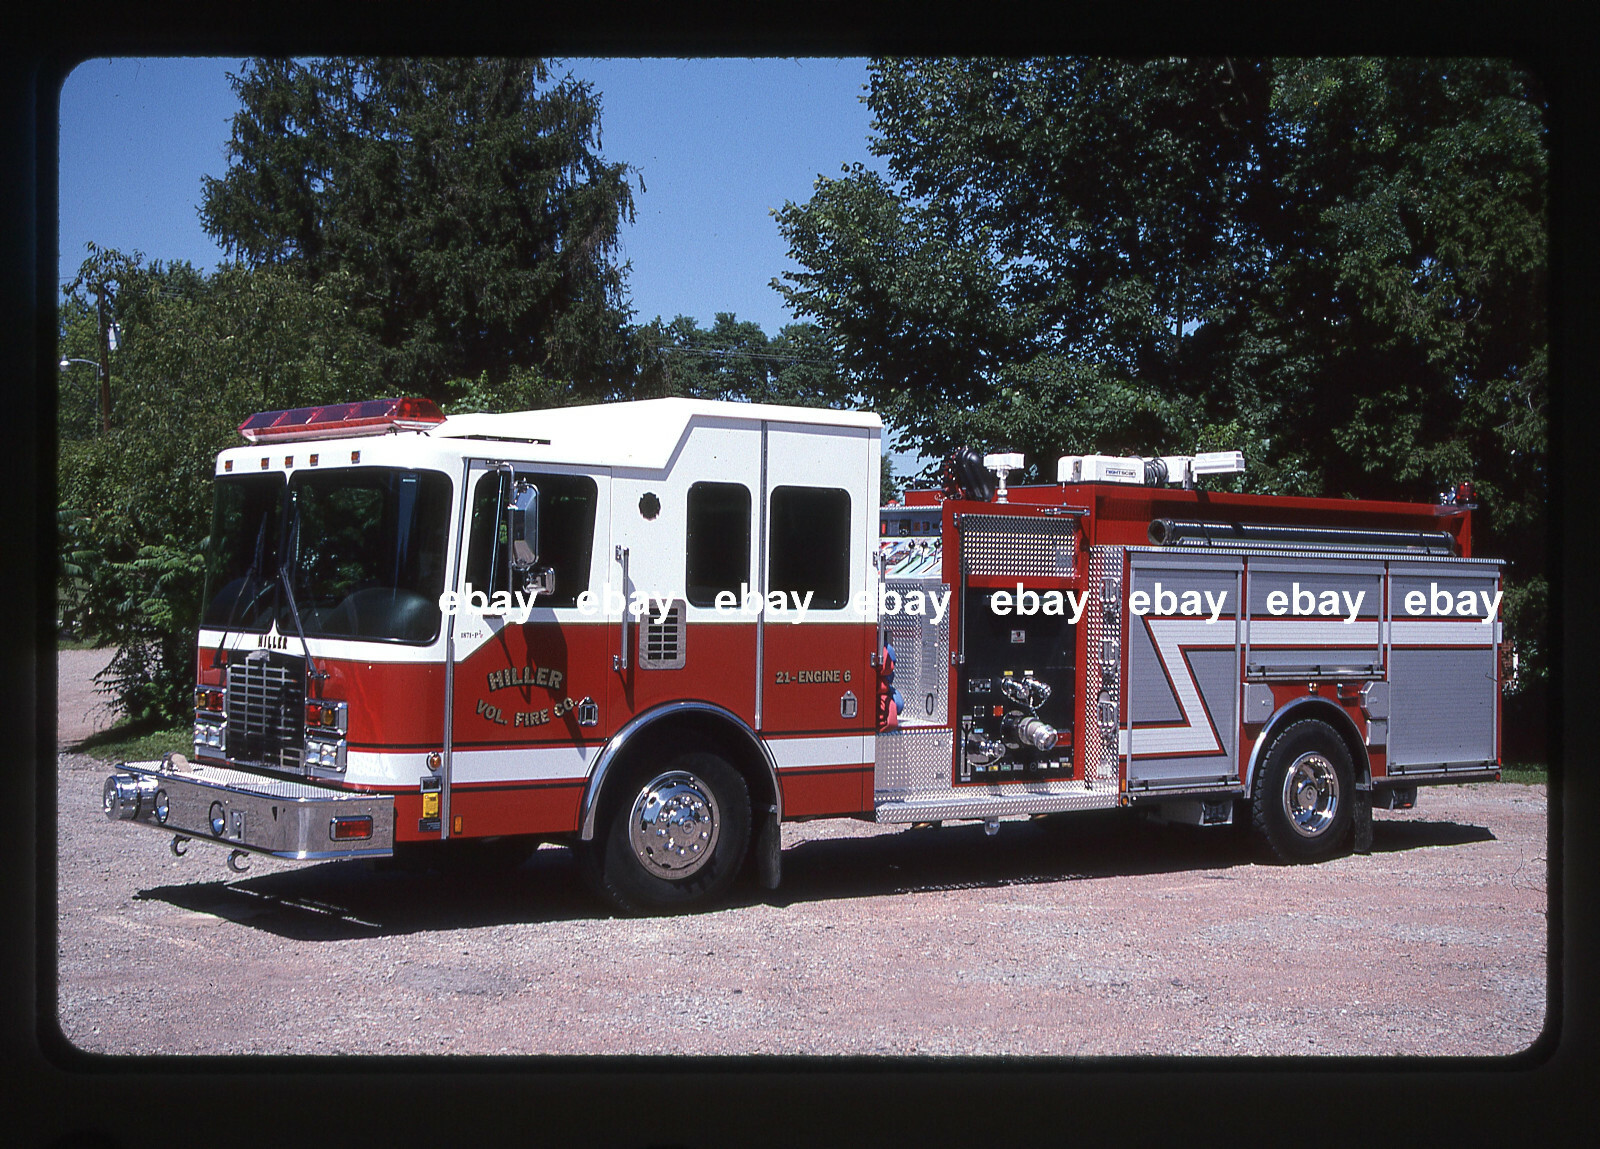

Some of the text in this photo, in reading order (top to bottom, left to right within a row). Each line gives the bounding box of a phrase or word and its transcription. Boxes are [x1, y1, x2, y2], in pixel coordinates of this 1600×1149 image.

[258, 634, 287, 649] HILLER
[487, 666, 563, 692] HILLER
[843, 669, 851, 682] 6
[476, 697, 579, 727] VOL. FIRE CO.
